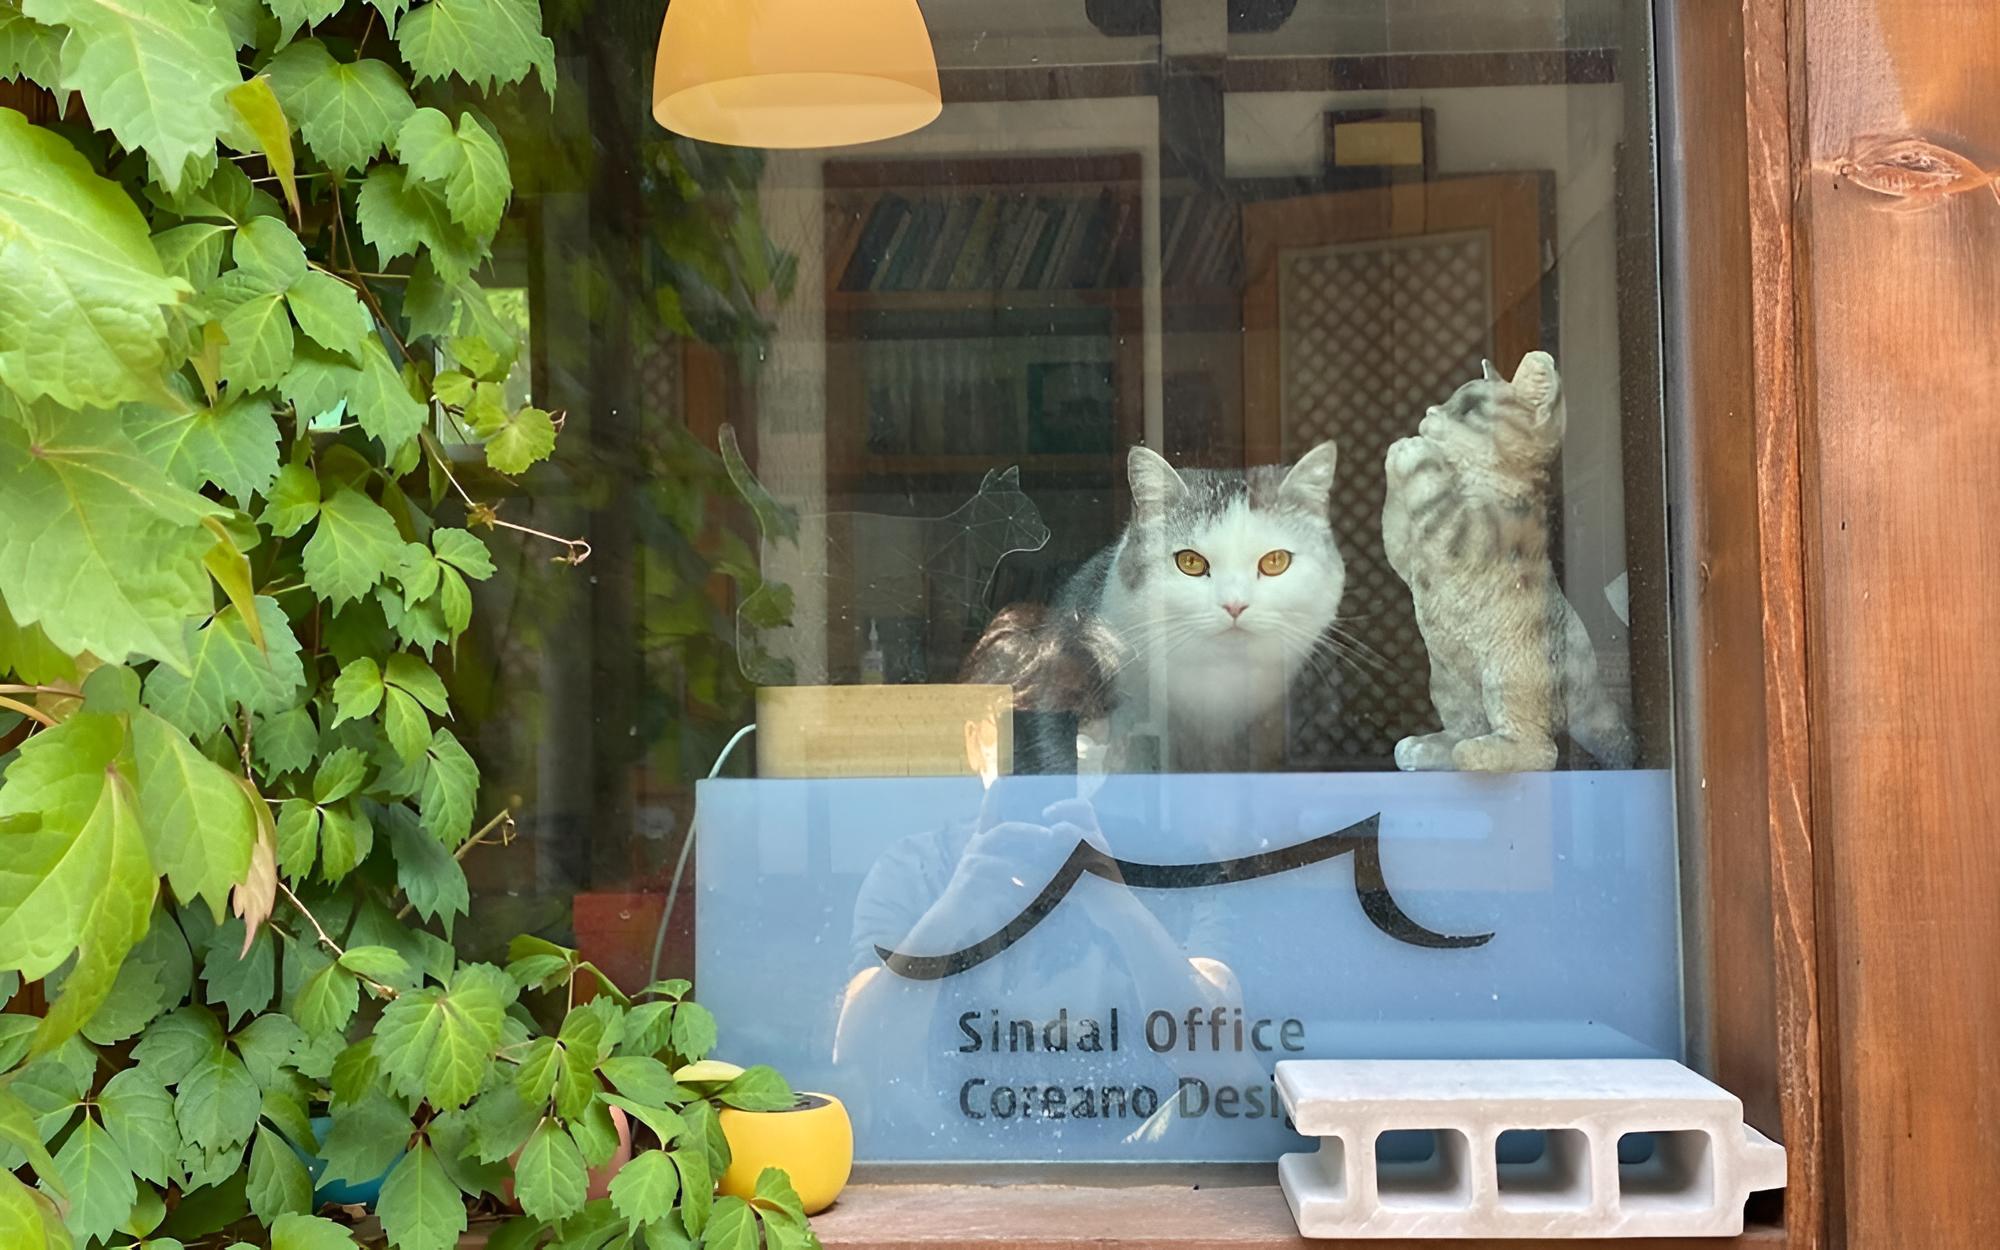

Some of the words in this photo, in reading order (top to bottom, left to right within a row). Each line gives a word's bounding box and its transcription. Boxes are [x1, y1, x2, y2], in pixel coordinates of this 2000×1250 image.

[958, 1007, 1118, 1052] Sindal
[1145, 1006, 1305, 1052] Office
[959, 1078, 1158, 1120] Coreano
[1178, 1076, 1296, 1130] Desi
